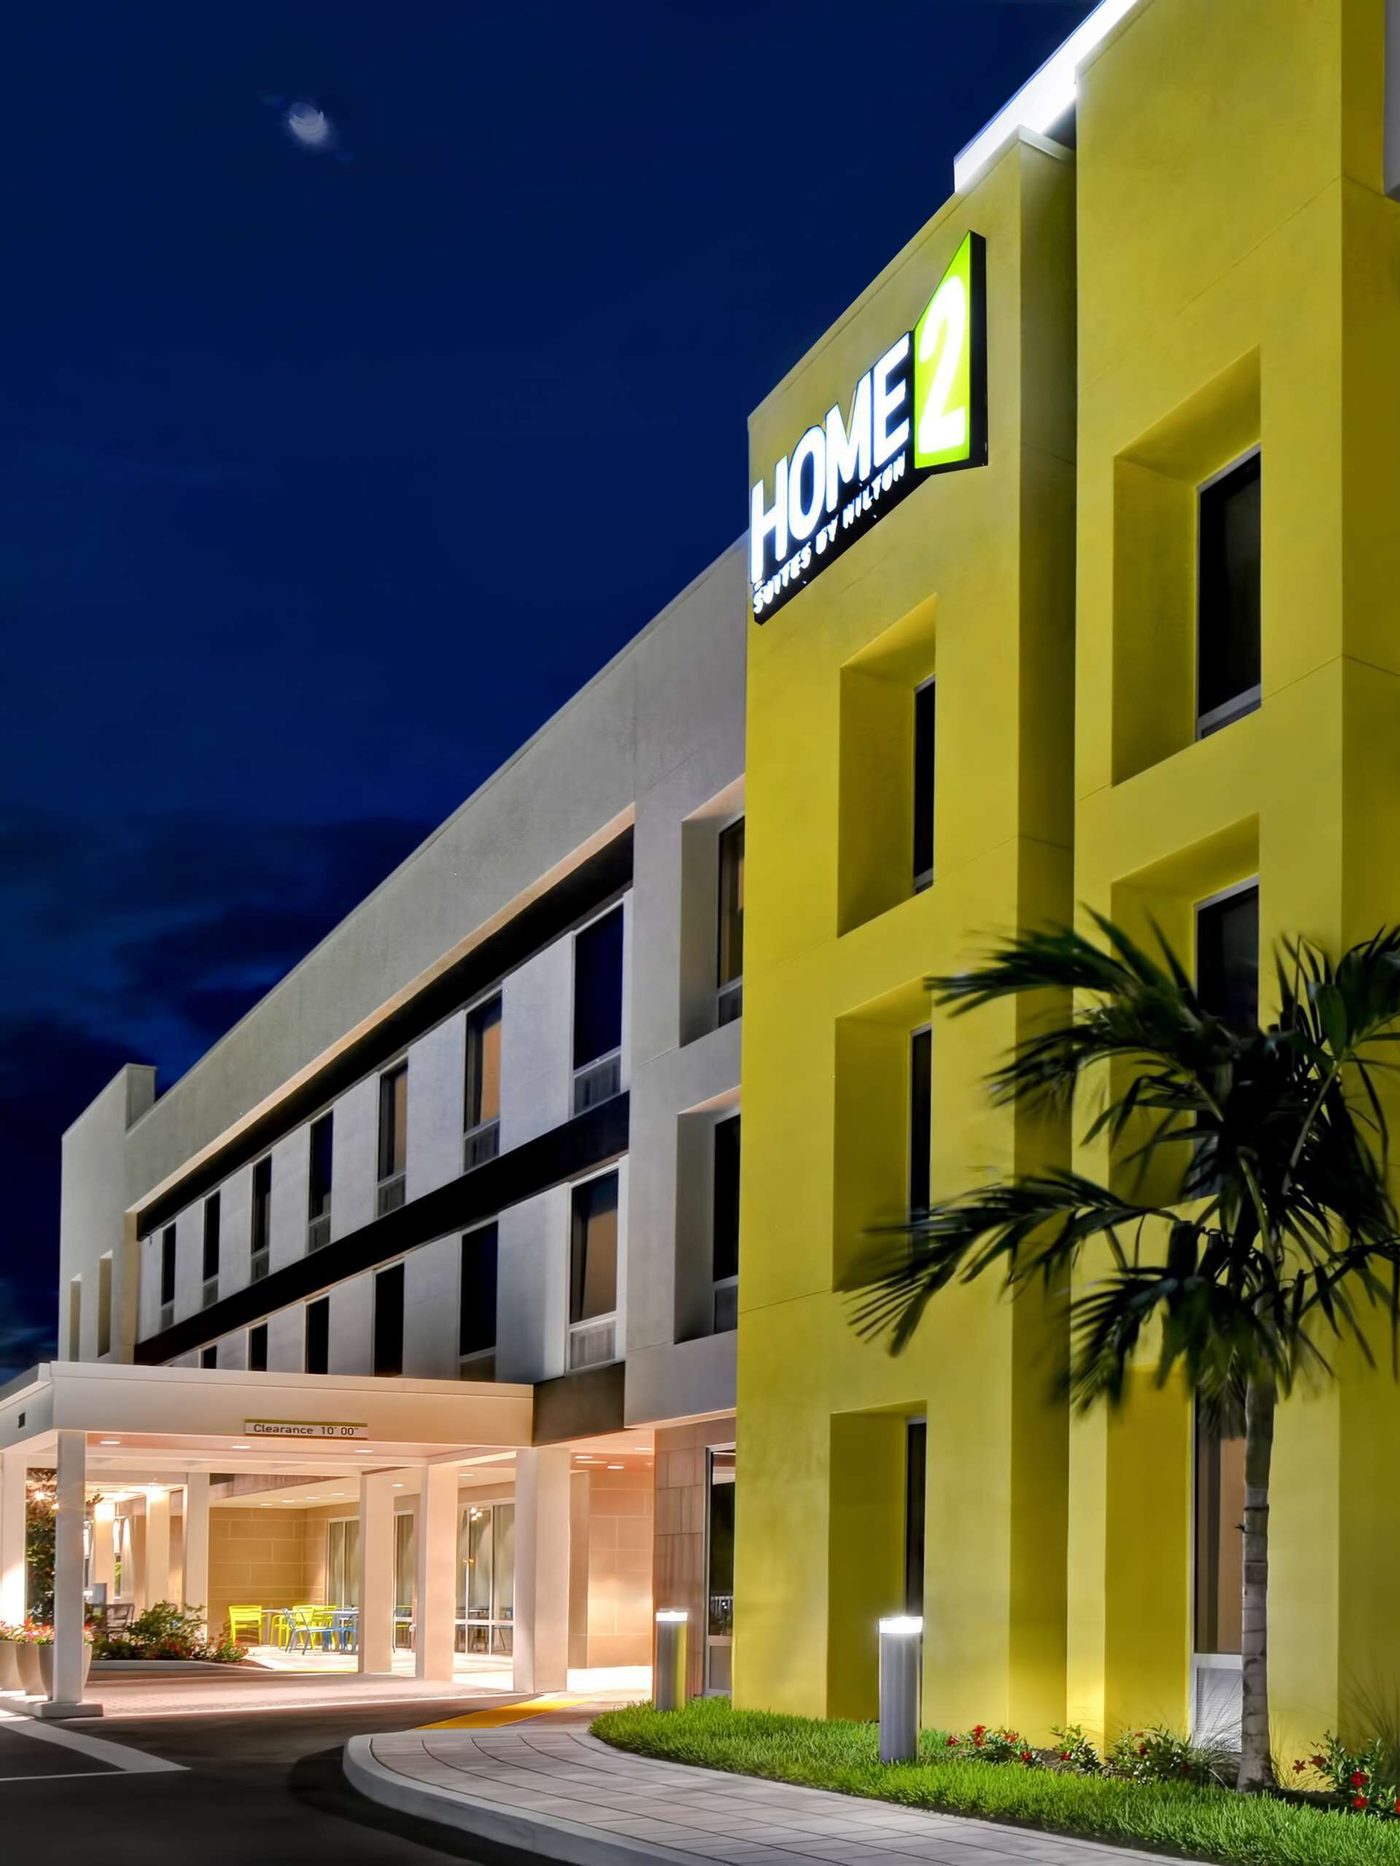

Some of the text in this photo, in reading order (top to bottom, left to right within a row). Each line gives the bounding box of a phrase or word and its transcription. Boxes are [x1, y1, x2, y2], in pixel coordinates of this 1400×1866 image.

[753, 450, 906, 614] SUITES BY HILTON
[253, 1423, 314, 1435] Clearance
